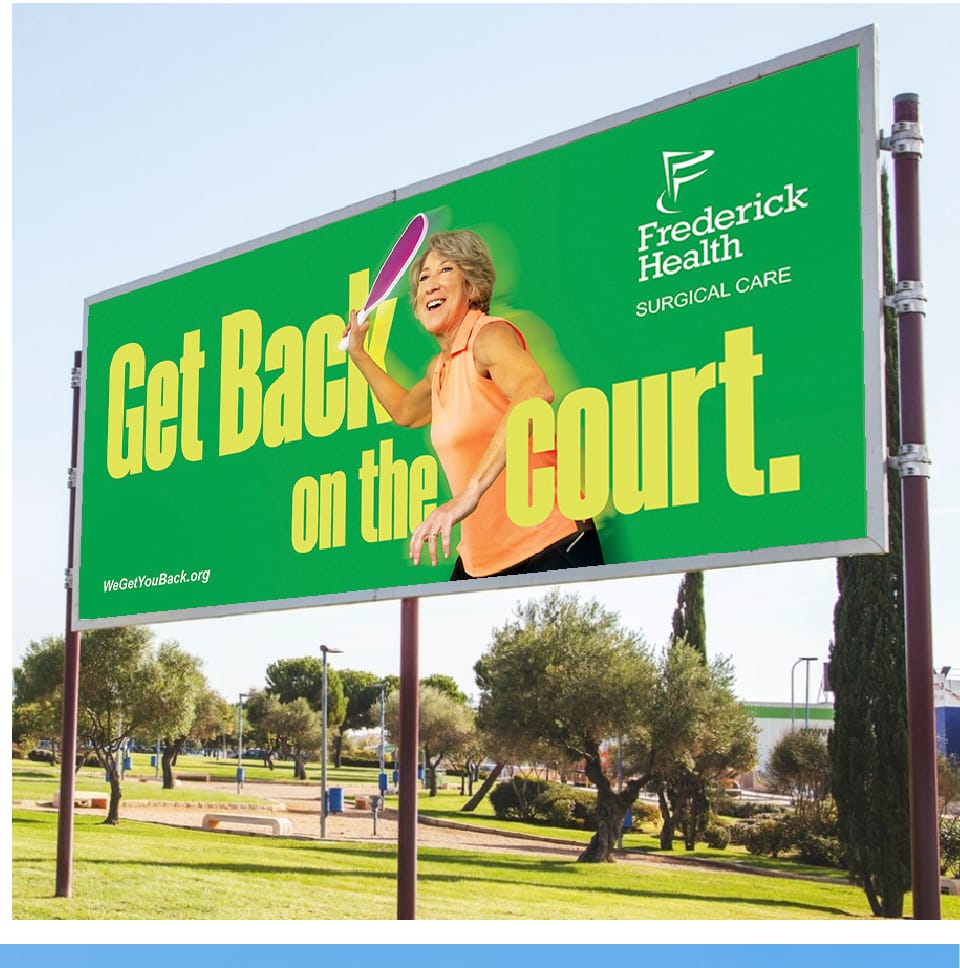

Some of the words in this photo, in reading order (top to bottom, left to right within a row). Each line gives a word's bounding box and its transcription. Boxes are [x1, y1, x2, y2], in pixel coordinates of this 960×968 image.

[637, 183, 808, 253] Frederick
[638, 234, 743, 282] Health
[635, 282, 731, 317] SURGICAL
[735, 266, 792, 293] CARE
[107, 330, 204, 479] Get
[218, 268, 397, 456] Back
[292, 470, 346, 553] on
[358, 438, 438, 543] the
[504, 327, 800, 528] court.
[103, 569, 211, 593] WeGetYouBack.org
